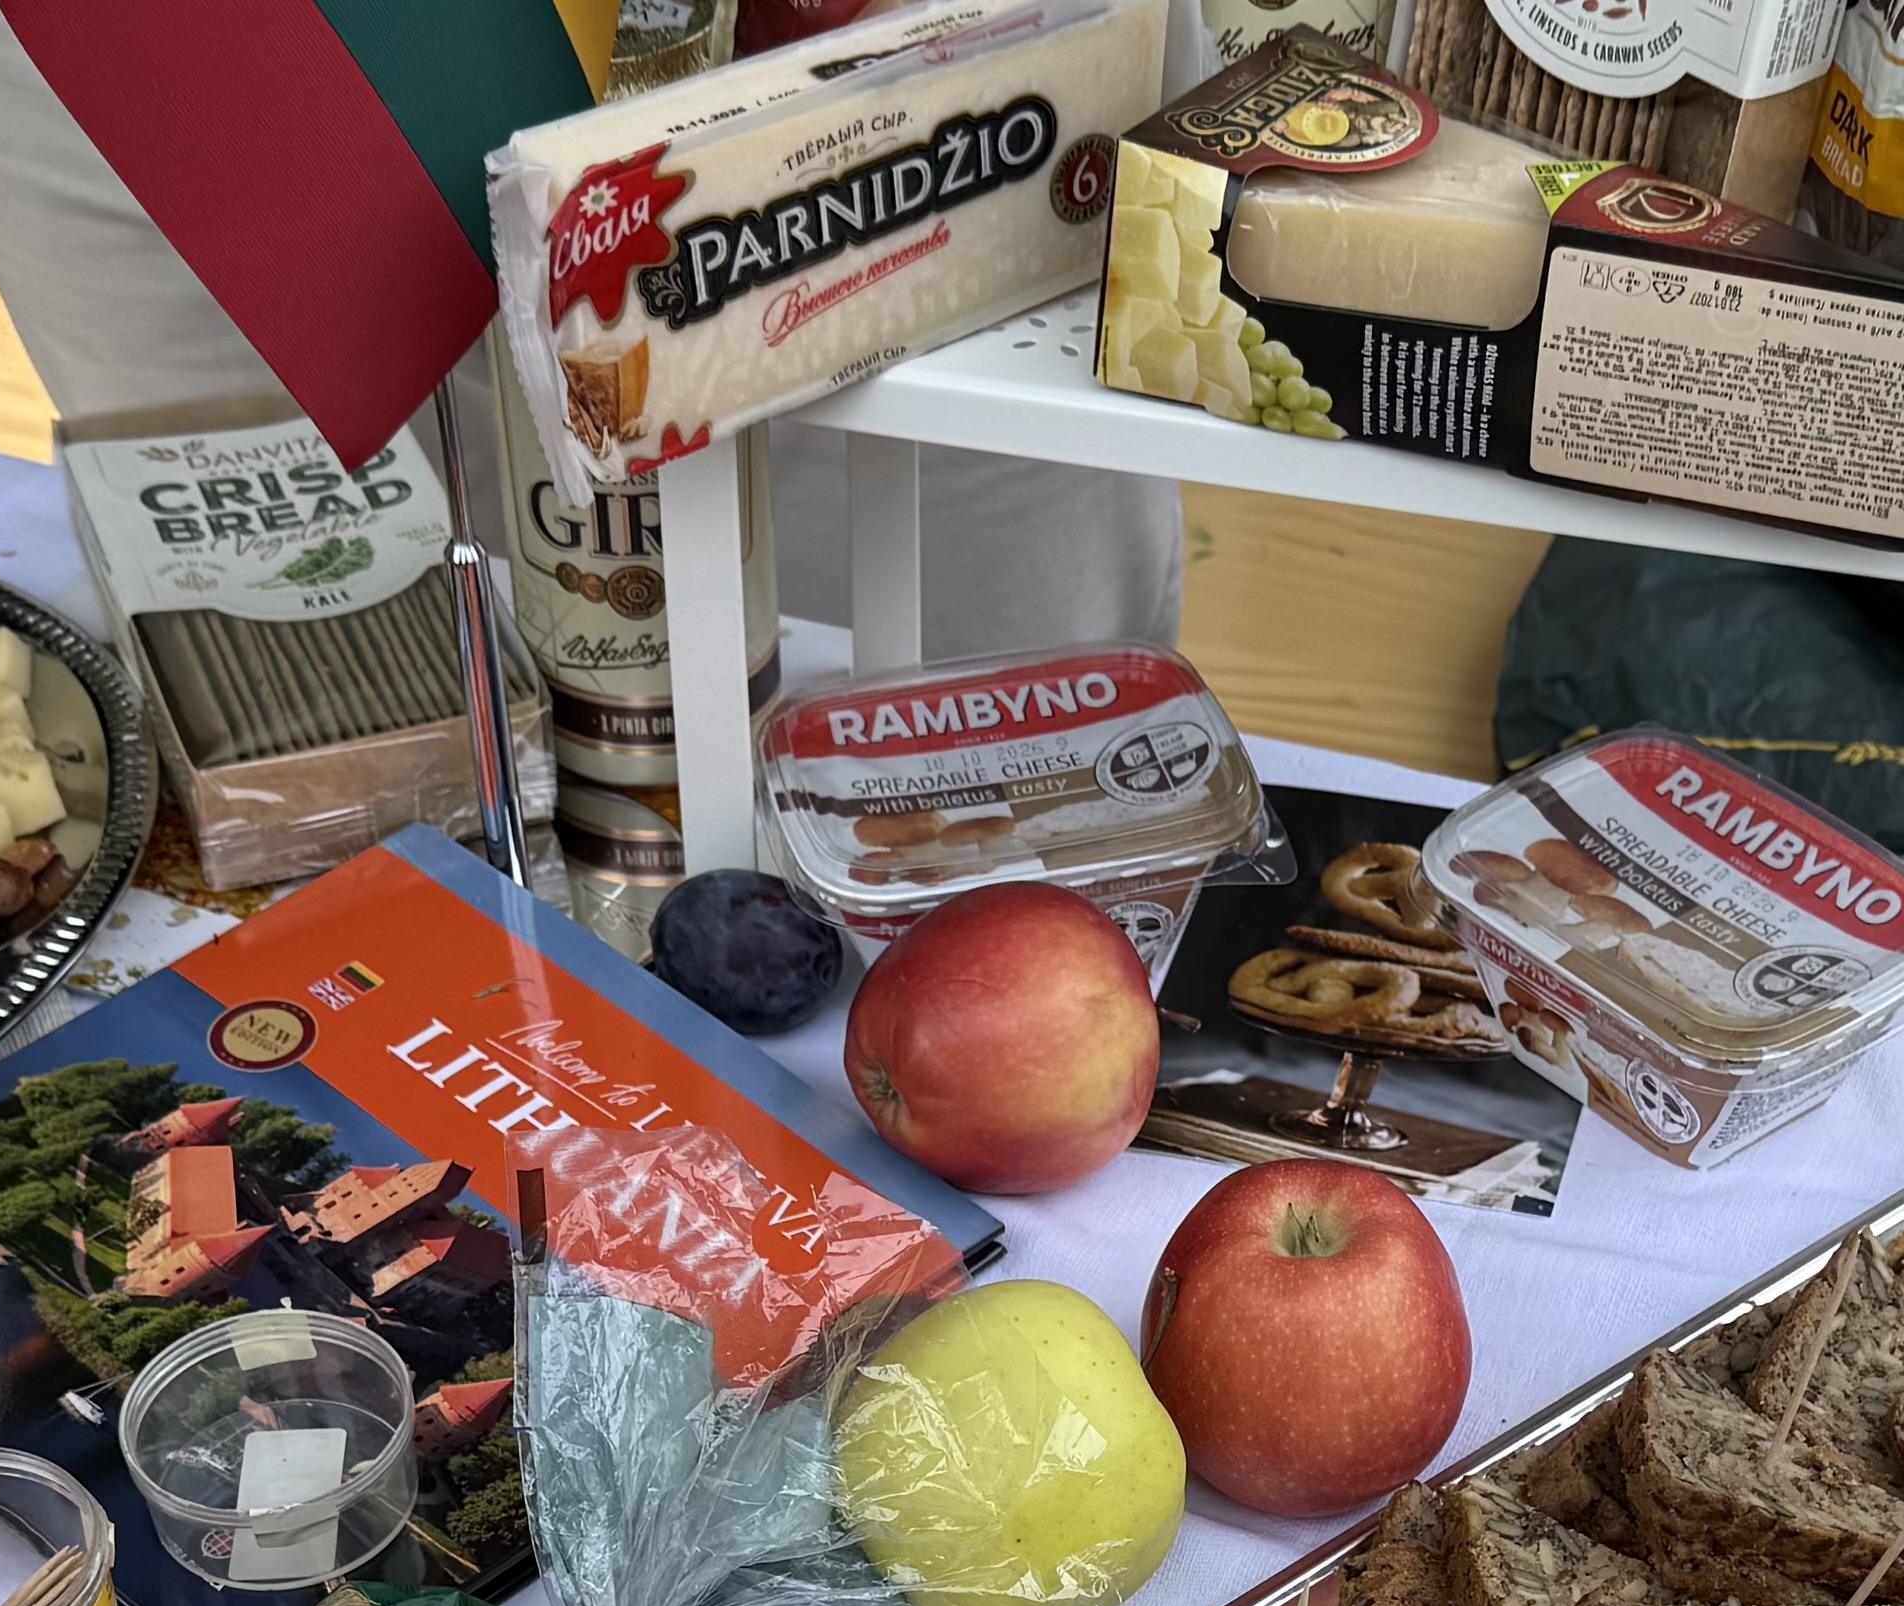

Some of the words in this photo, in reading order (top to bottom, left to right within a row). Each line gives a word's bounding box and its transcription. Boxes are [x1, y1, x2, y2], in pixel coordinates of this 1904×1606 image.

[1593, 42, 1644, 64] CARAWAY
[1647, 20, 1682, 58] SEEEDS
[1830, 88, 1874, 166] DARK
[687, 107, 1045, 306] PARNIDŽIO
[1072, 163, 1098, 202] 6
[156, 477, 413, 547] BREAD
[527, 479, 663, 559] GIR
[827, 671, 1118, 747] RAMBYNO
[851, 764, 988, 796] SPREADABLE
[1001, 751, 1085, 780] CHEESE
[863, 794, 915, 817] with
[918, 785, 997, 811] boletus
[1011, 775, 1068, 799] tasty
[1596, 816, 1712, 898] SPREADABLE
[1711, 896, 1787, 944] CHEESE
[1655, 766, 1904, 928] RAMBYNO
[1580, 831, 1619, 869] with
[1618, 859, 1685, 915] boletus
[1689, 909, 1741, 946] tasty
[238, 1007, 294, 1041] NEW
[384, 1016, 771, 1306] LITHUANIA
